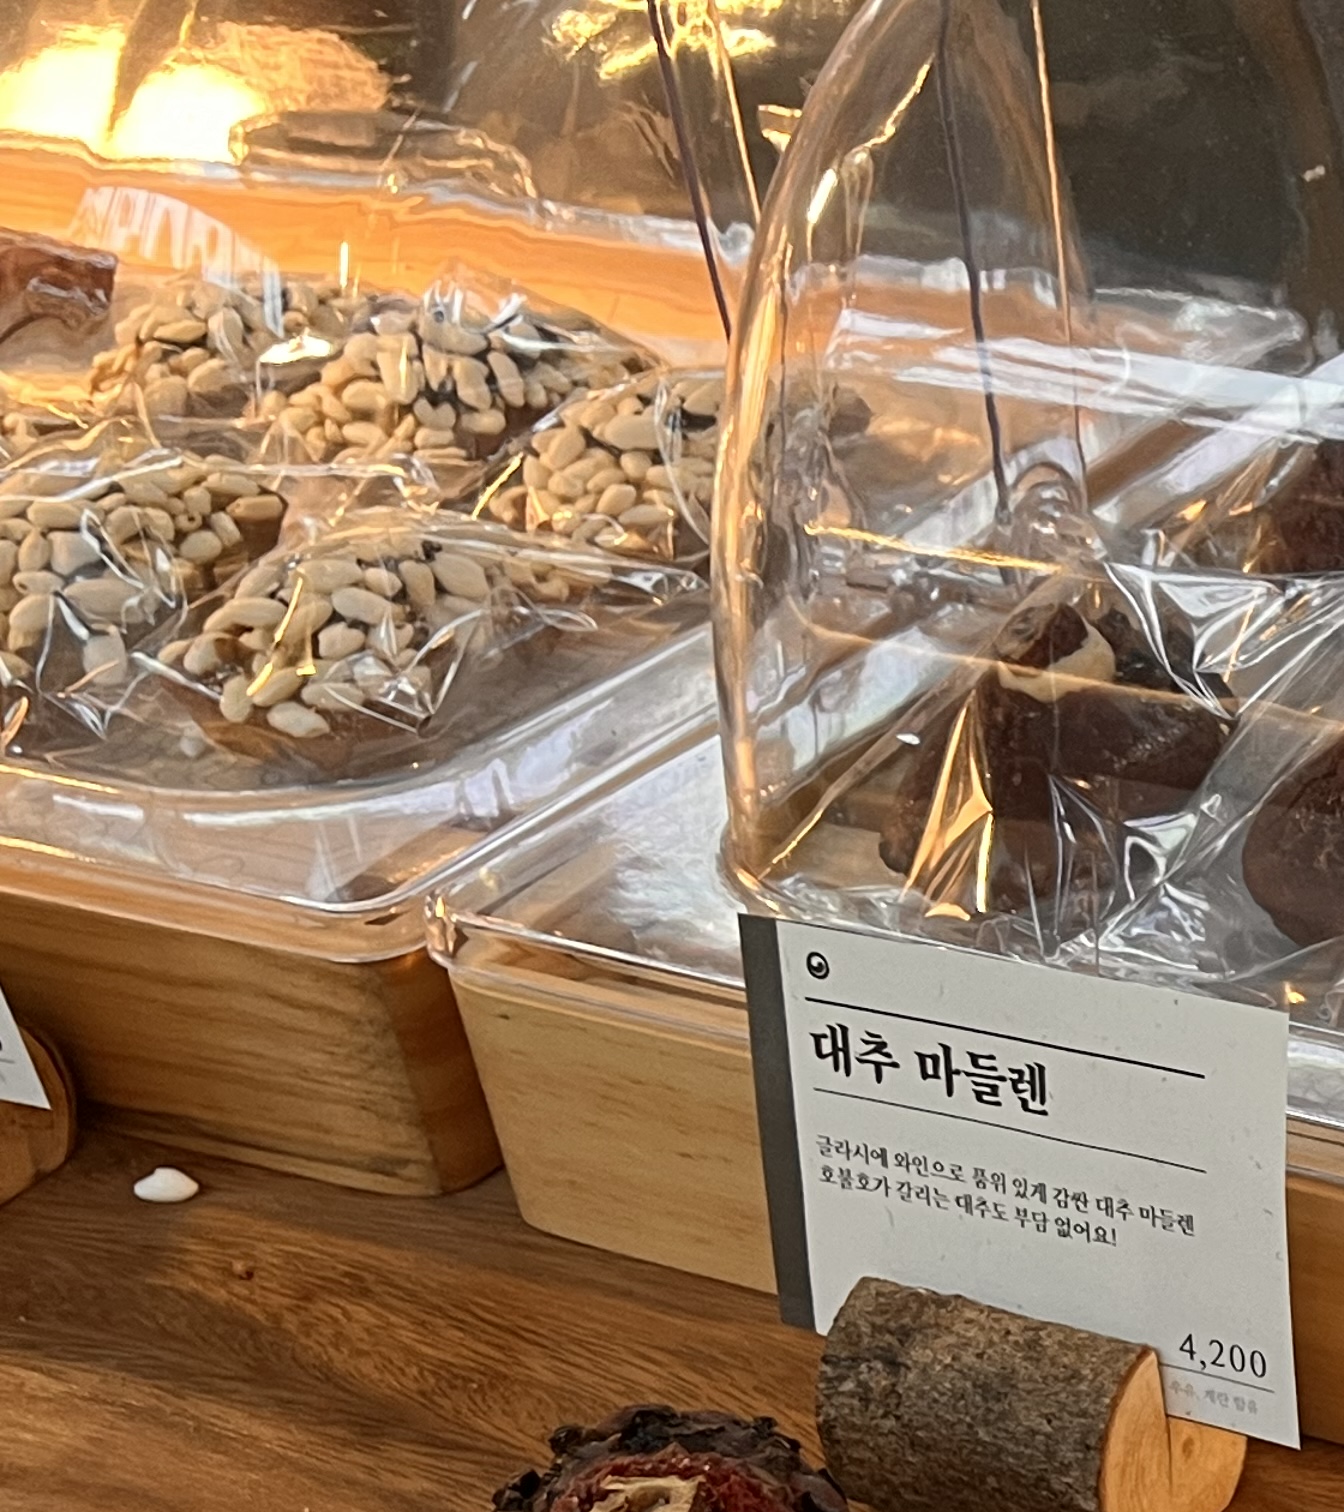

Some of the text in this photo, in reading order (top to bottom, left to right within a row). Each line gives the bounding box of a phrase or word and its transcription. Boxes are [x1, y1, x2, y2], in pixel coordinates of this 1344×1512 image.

[808, 1023, 1048, 1117] 대추 마들렌
[816, 1134, 1195, 1237] 글라시에 와인으로 품위 있게 감싼 대추 마들렌
[820, 1165, 1118, 1247] 호불호가 갈리는 대추도 부담 없어요!
[1179, 1333, 1267, 1379] 4,200
